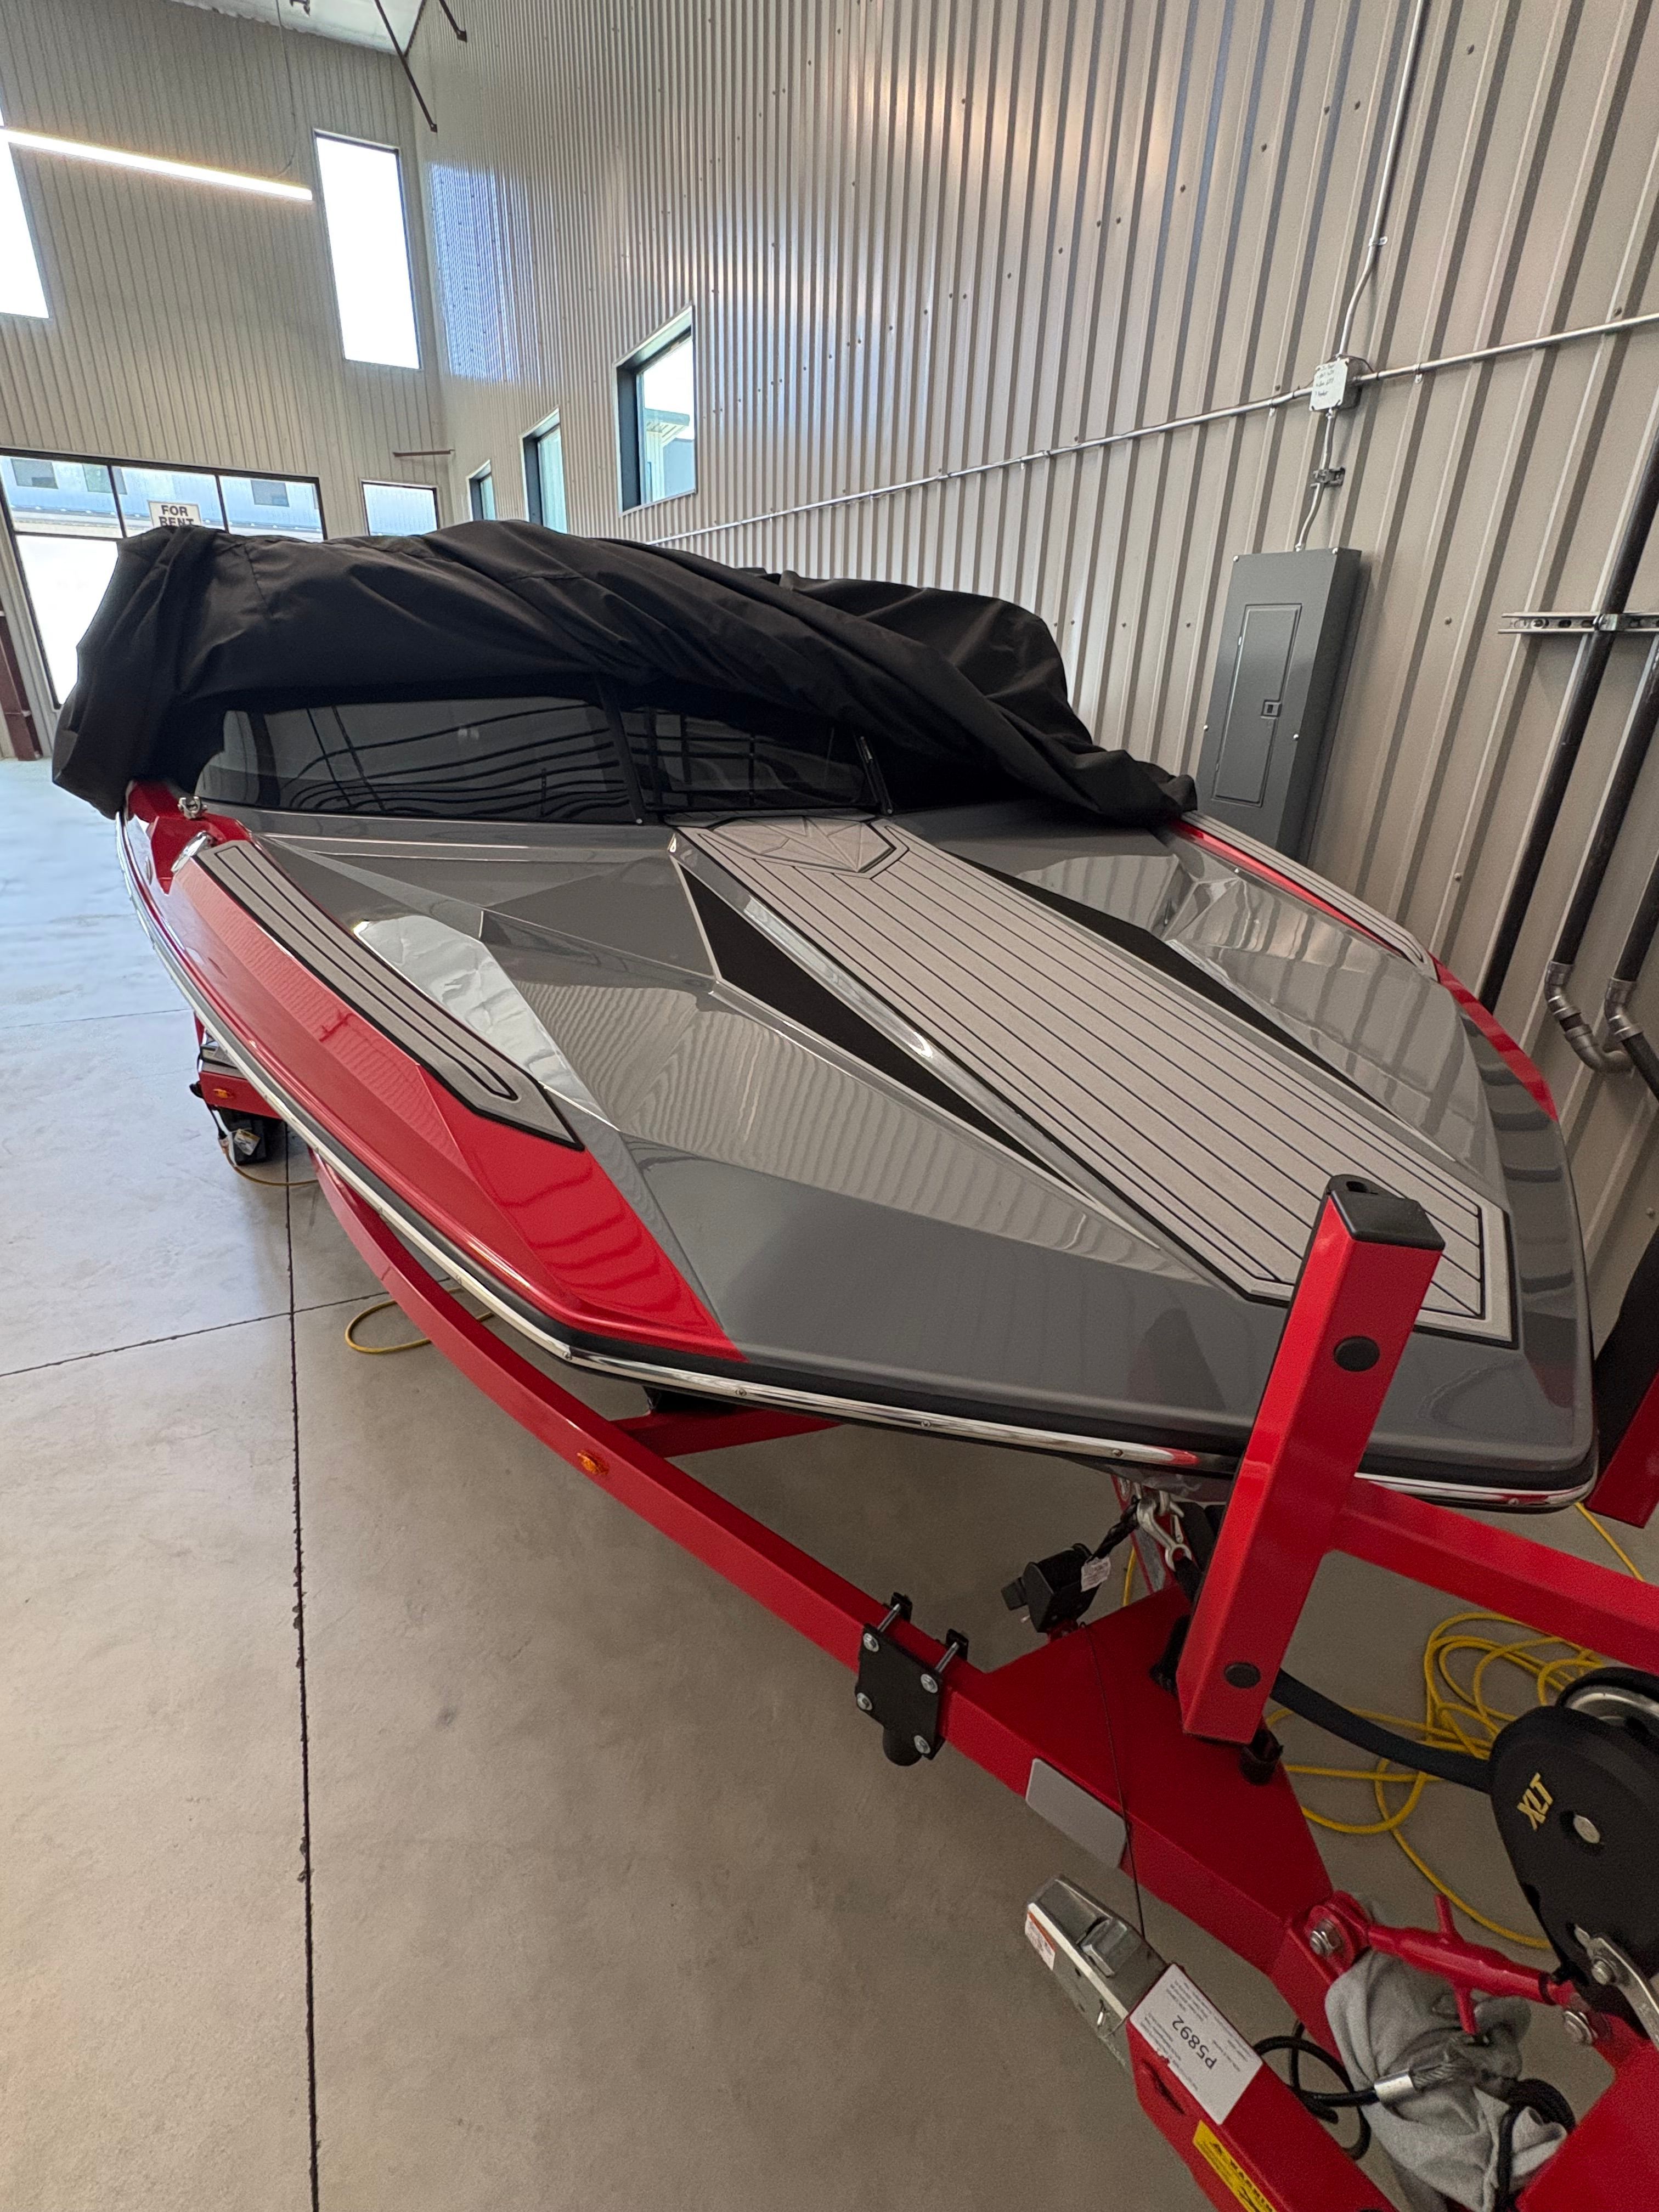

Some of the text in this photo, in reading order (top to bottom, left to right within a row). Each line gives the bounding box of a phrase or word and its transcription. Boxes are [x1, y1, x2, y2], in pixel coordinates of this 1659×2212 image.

[159, 516, 194, 527] RENT
[161, 505, 189, 516] FOR
[1516, 1772, 1554, 1832] XLT
[1172, 2015, 1217, 2070] P5892
